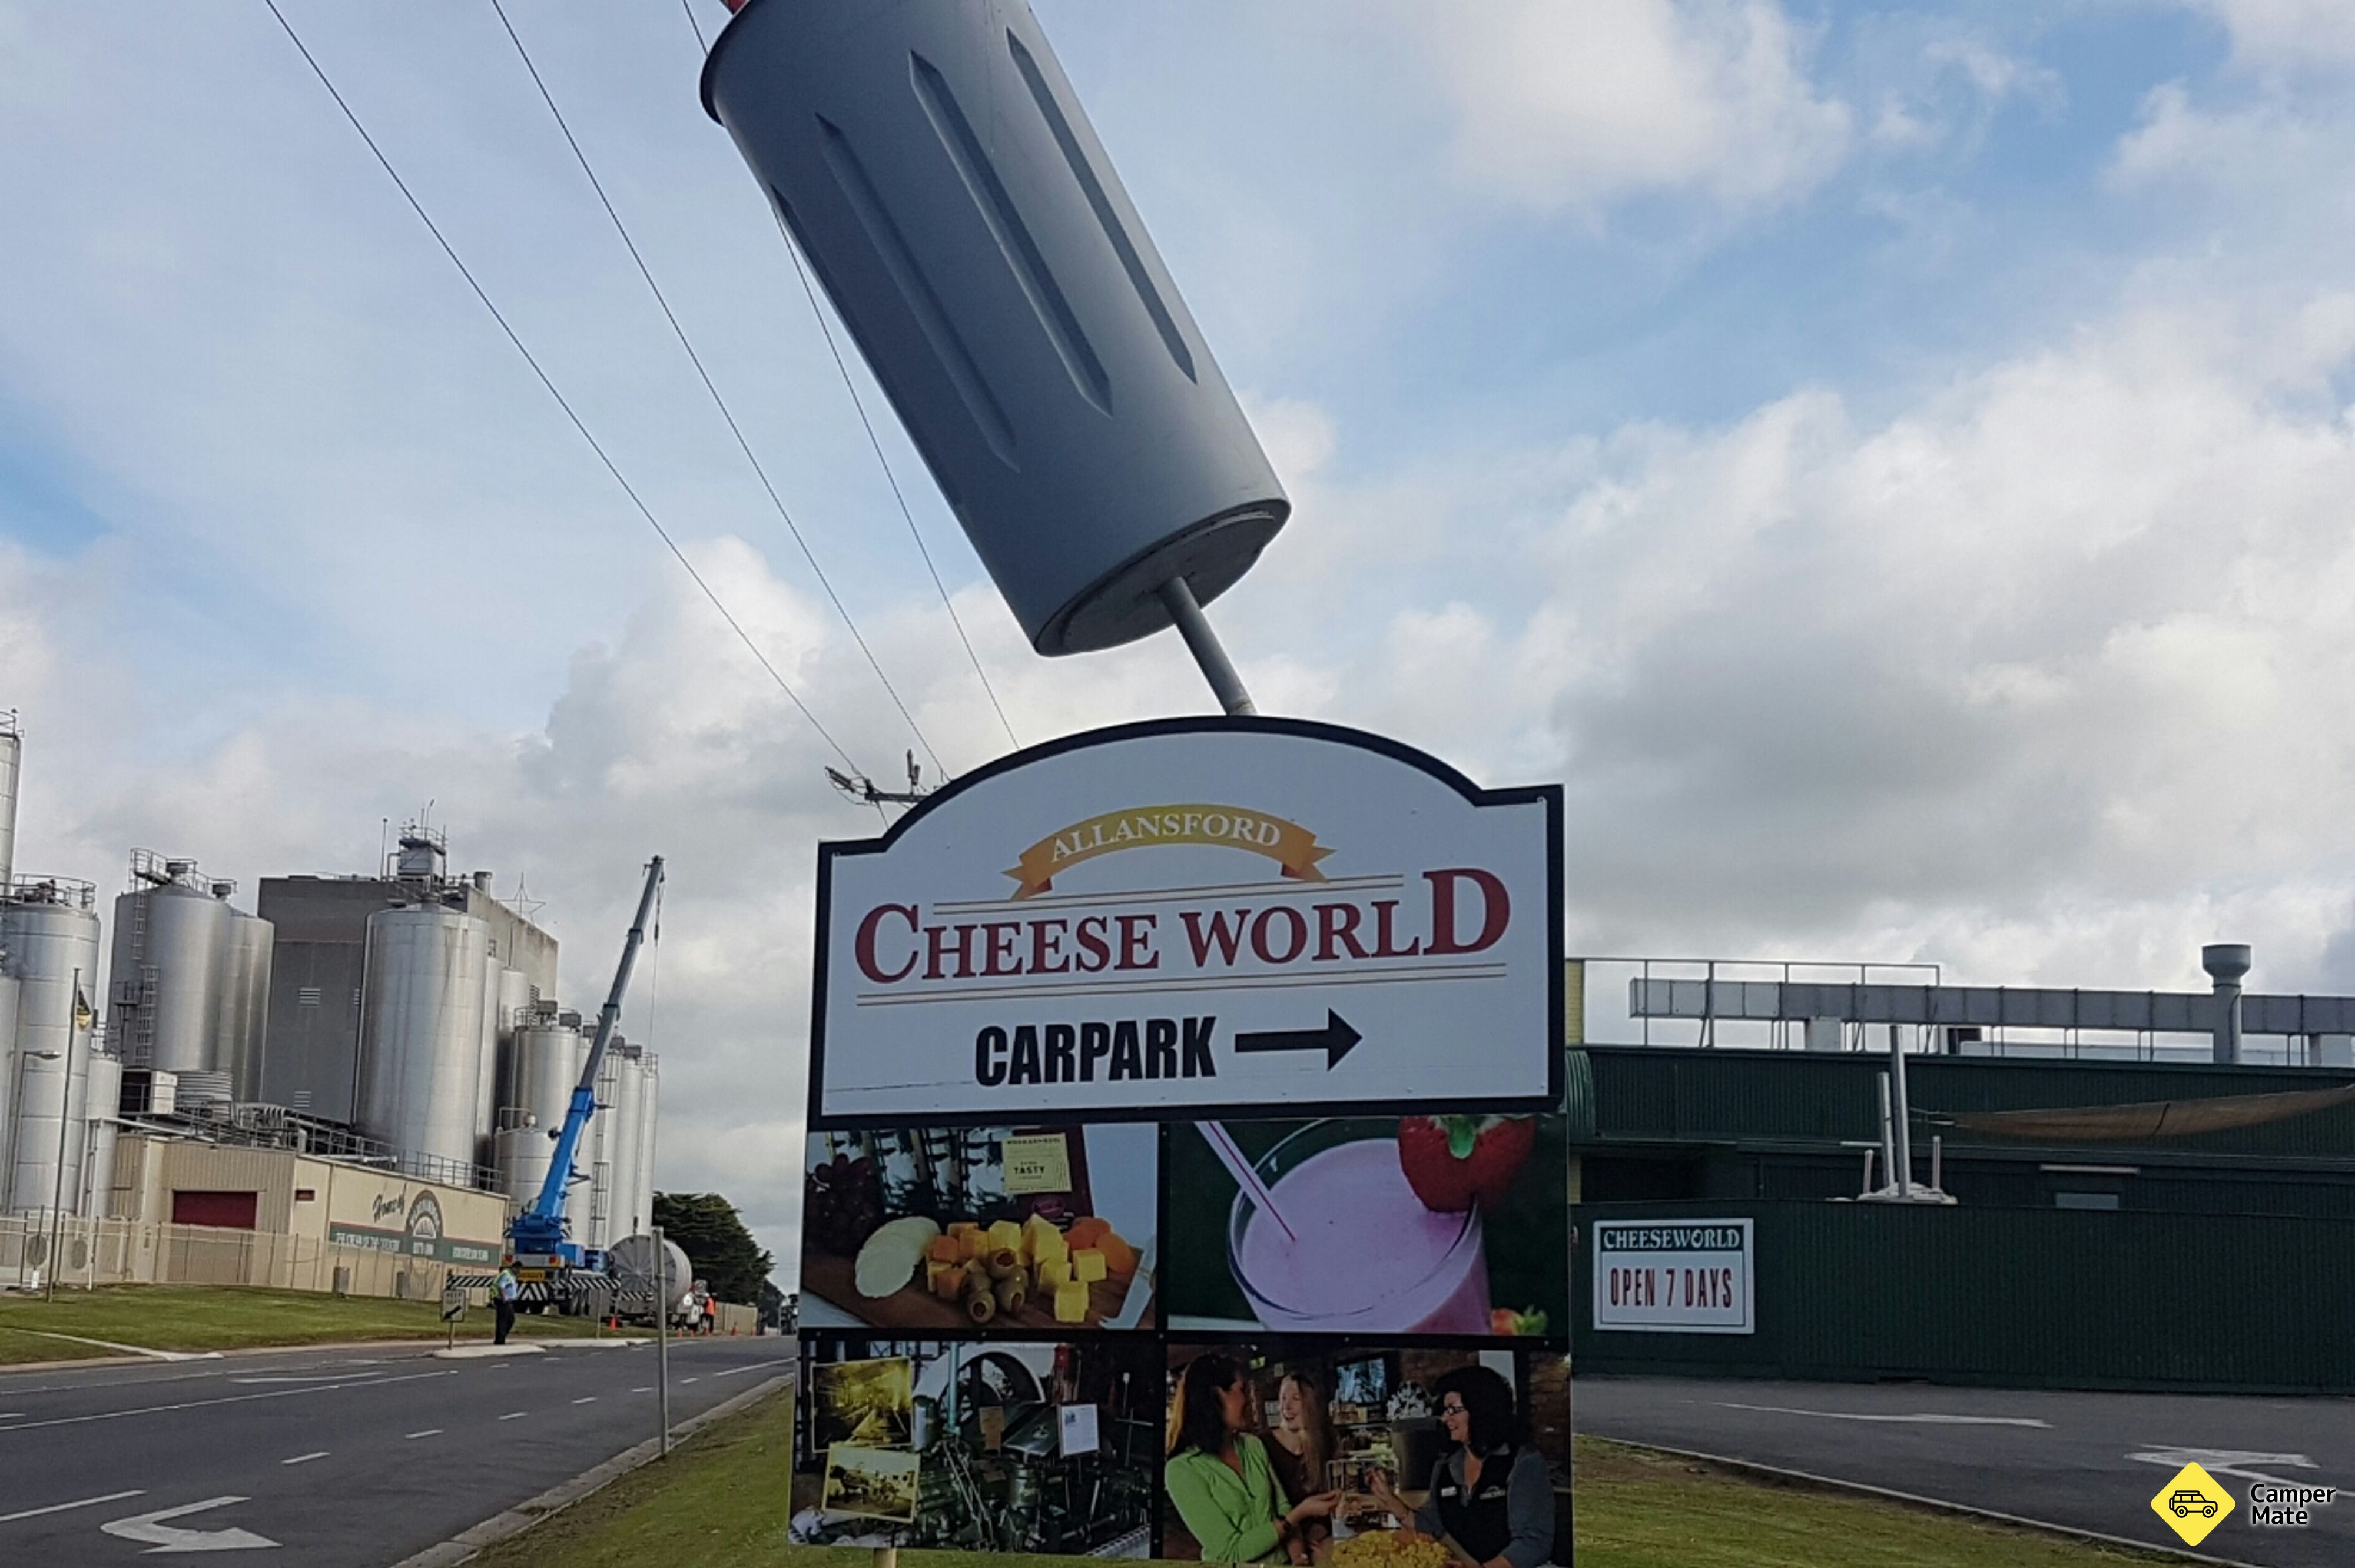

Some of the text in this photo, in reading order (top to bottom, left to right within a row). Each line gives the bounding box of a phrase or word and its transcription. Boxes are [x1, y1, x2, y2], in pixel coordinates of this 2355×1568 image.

[1050, 813, 1281, 863] ALLANSFORD
[854, 867, 1511, 984] CHEESE WORLD
[974, 1016, 1218, 1087] CARPARK
[1013, 1165, 1045, 1175] TASTY
[1603, 1228, 1740, 1249] CHEESEWORLD
[1610, 1267, 1732, 1308] OPEN 7 DAYS
